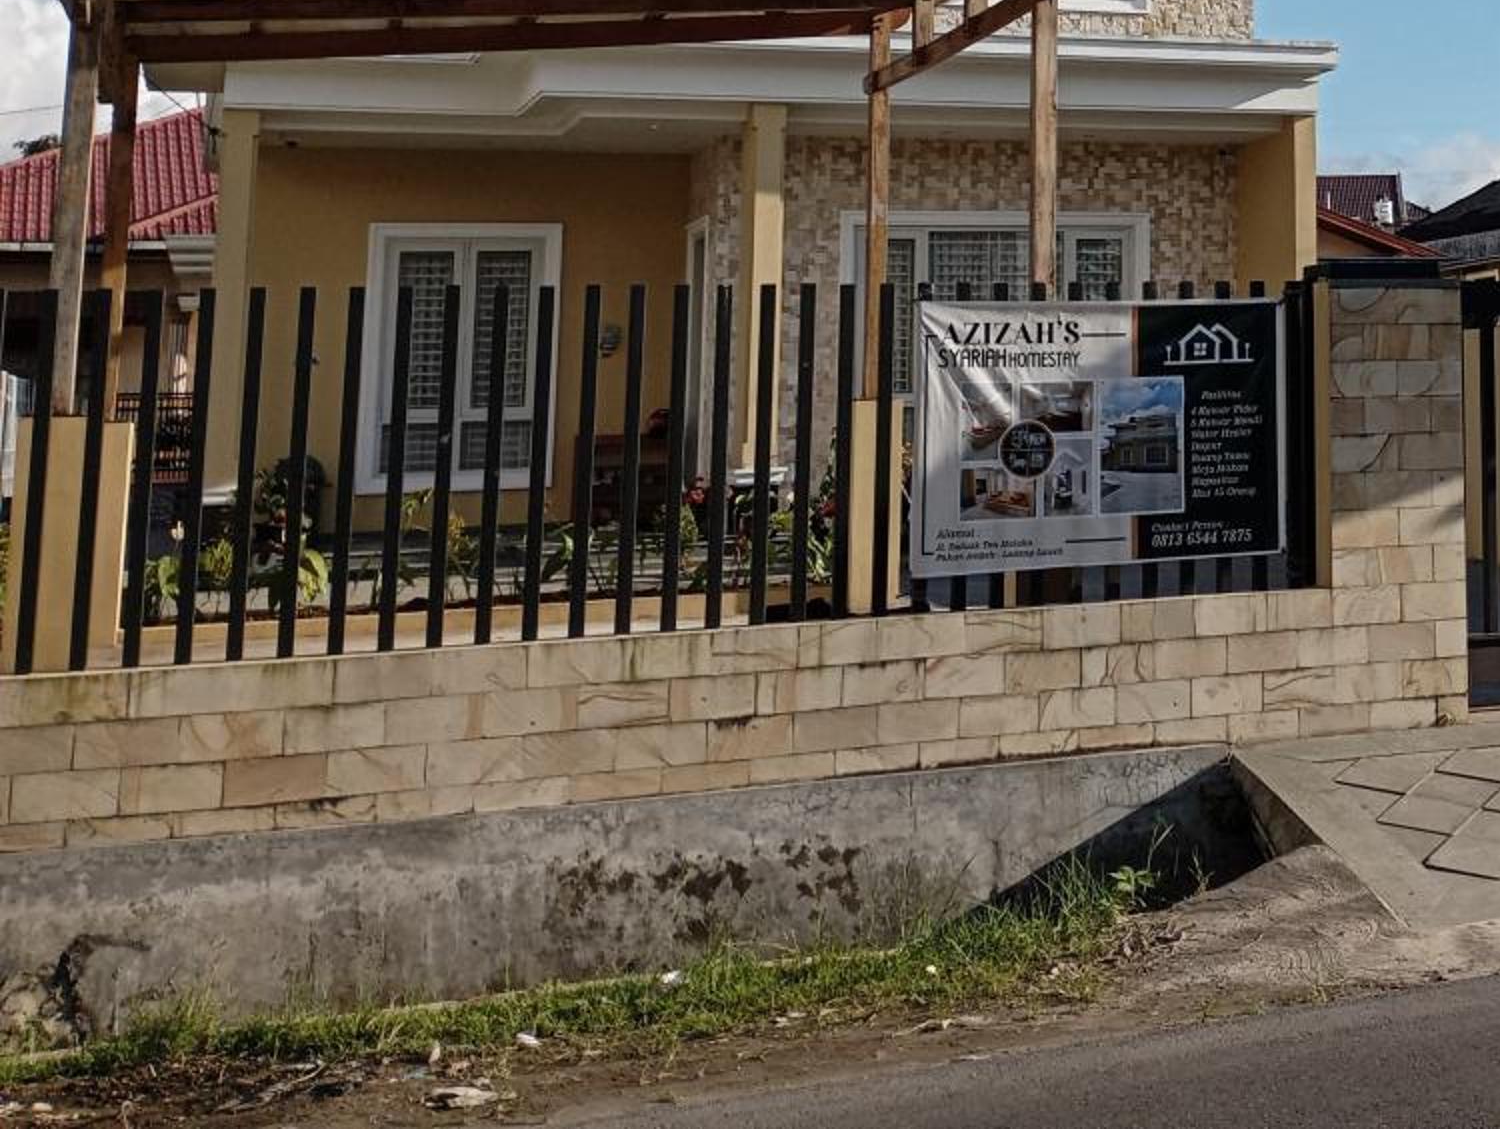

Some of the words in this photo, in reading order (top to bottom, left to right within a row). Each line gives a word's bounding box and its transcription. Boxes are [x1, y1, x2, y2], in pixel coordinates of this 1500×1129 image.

[943, 320, 1081, 346] AZIZAH'S
[938, 348, 1007, 368] SYARIAH
[1008, 350, 1081, 368] HOMESTAY
